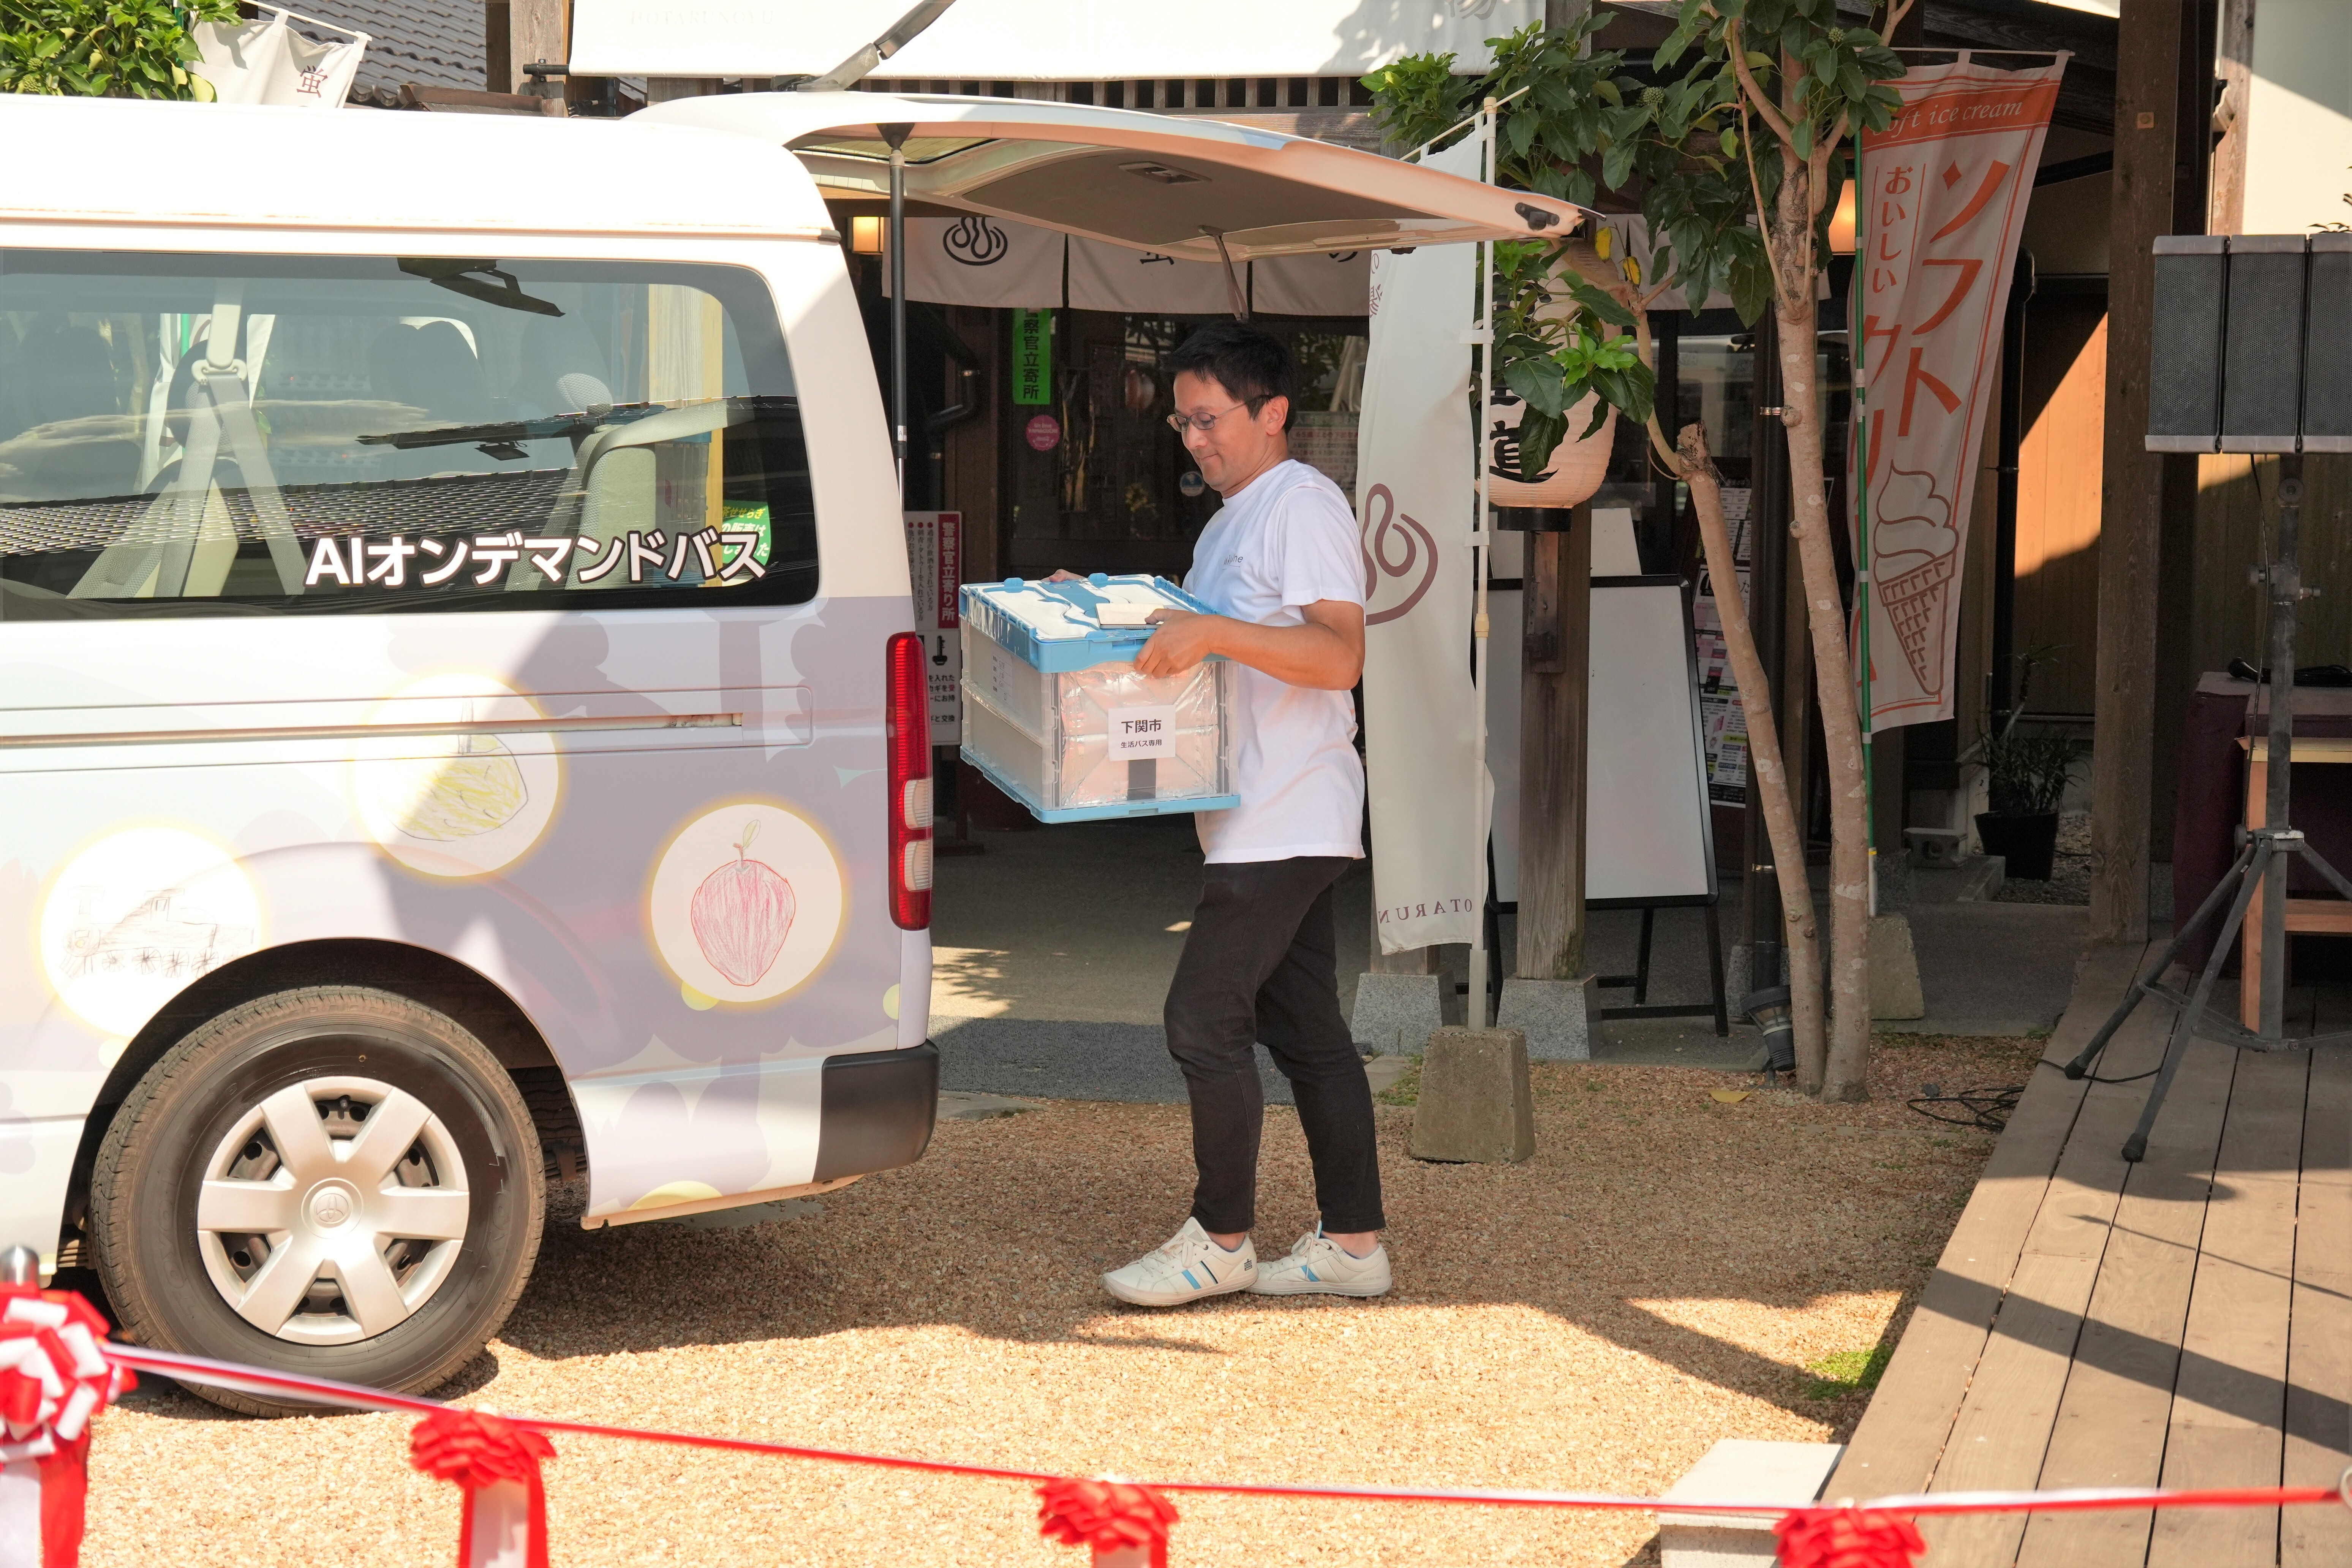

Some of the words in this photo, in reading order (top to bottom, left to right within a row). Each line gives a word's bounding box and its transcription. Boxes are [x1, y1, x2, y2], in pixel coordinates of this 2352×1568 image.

[630, 10, 774, 25] HOTARUNOYU
[1873, 107, 1920, 138] oft
[1929, 104, 1959, 125] ice
[1962, 102, 2023, 121] cream
[1872, 166, 1913, 293] おいしい
[1898, 160, 2010, 437] ソフト
[1023, 313, 1039, 399] 察官立寄所
[304, 528, 767, 586] AIオンデマンドバス
[942, 522, 955, 621] 警察官立寄り所
[1121, 719, 1162, 734] 下関市
[1121, 739, 1162, 748] 生活バス専用
